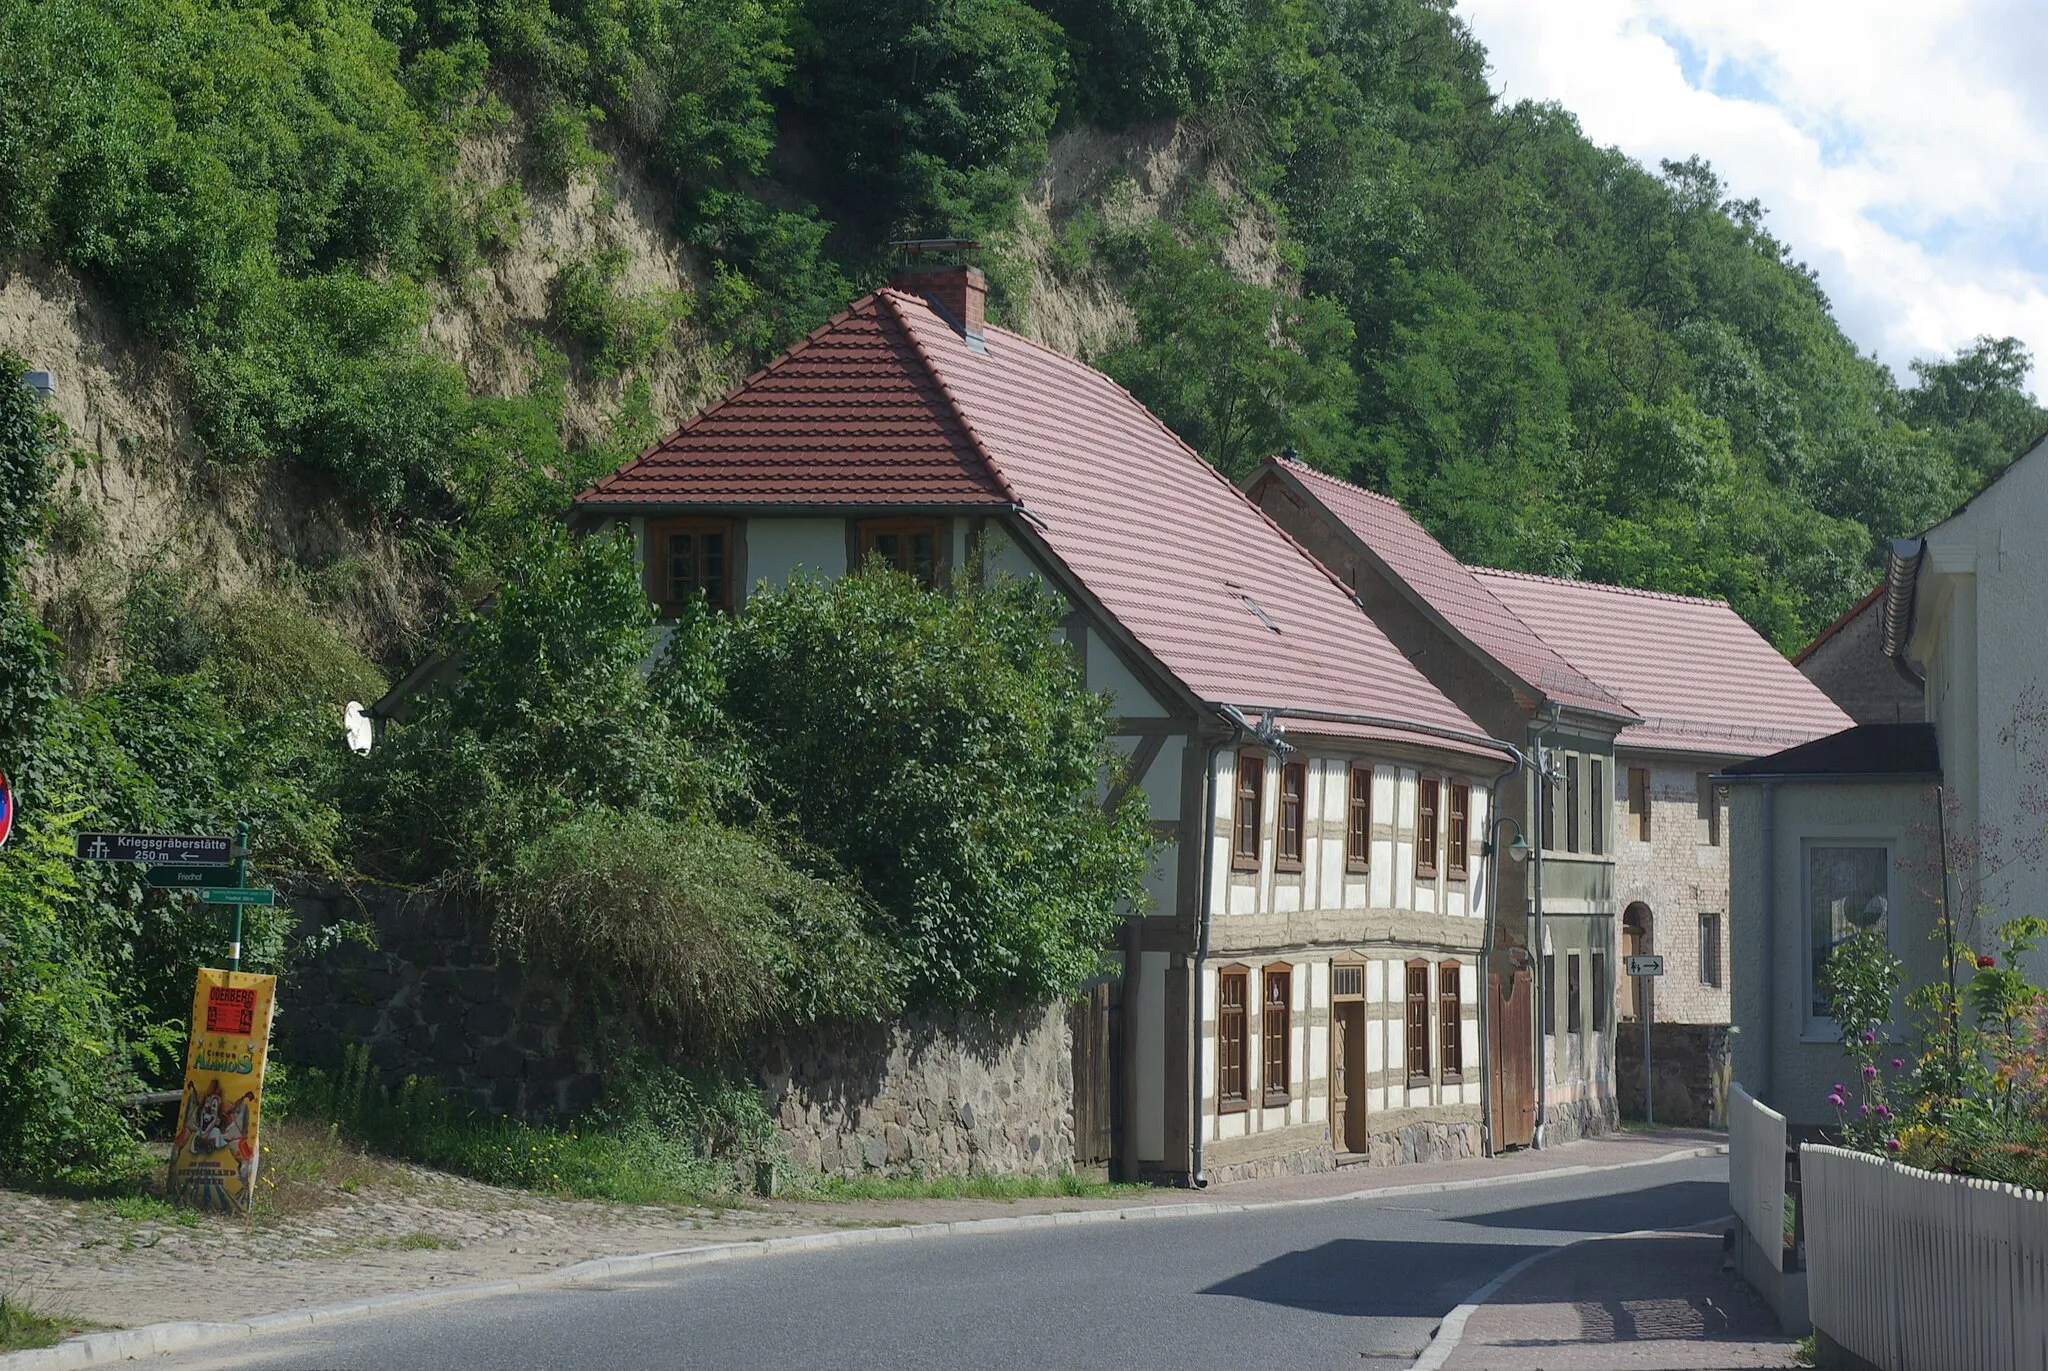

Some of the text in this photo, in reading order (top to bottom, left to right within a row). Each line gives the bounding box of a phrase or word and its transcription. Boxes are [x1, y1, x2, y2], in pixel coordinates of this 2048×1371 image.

[117, 836, 227, 850] Kriegsgräberstätte
[134, 850, 169, 860] 250 m
[177, 872, 203, 881] Friedhof
[210, 986, 254, 1003] ODERBERG
[207, 1049, 237, 1059] CIRCUS
